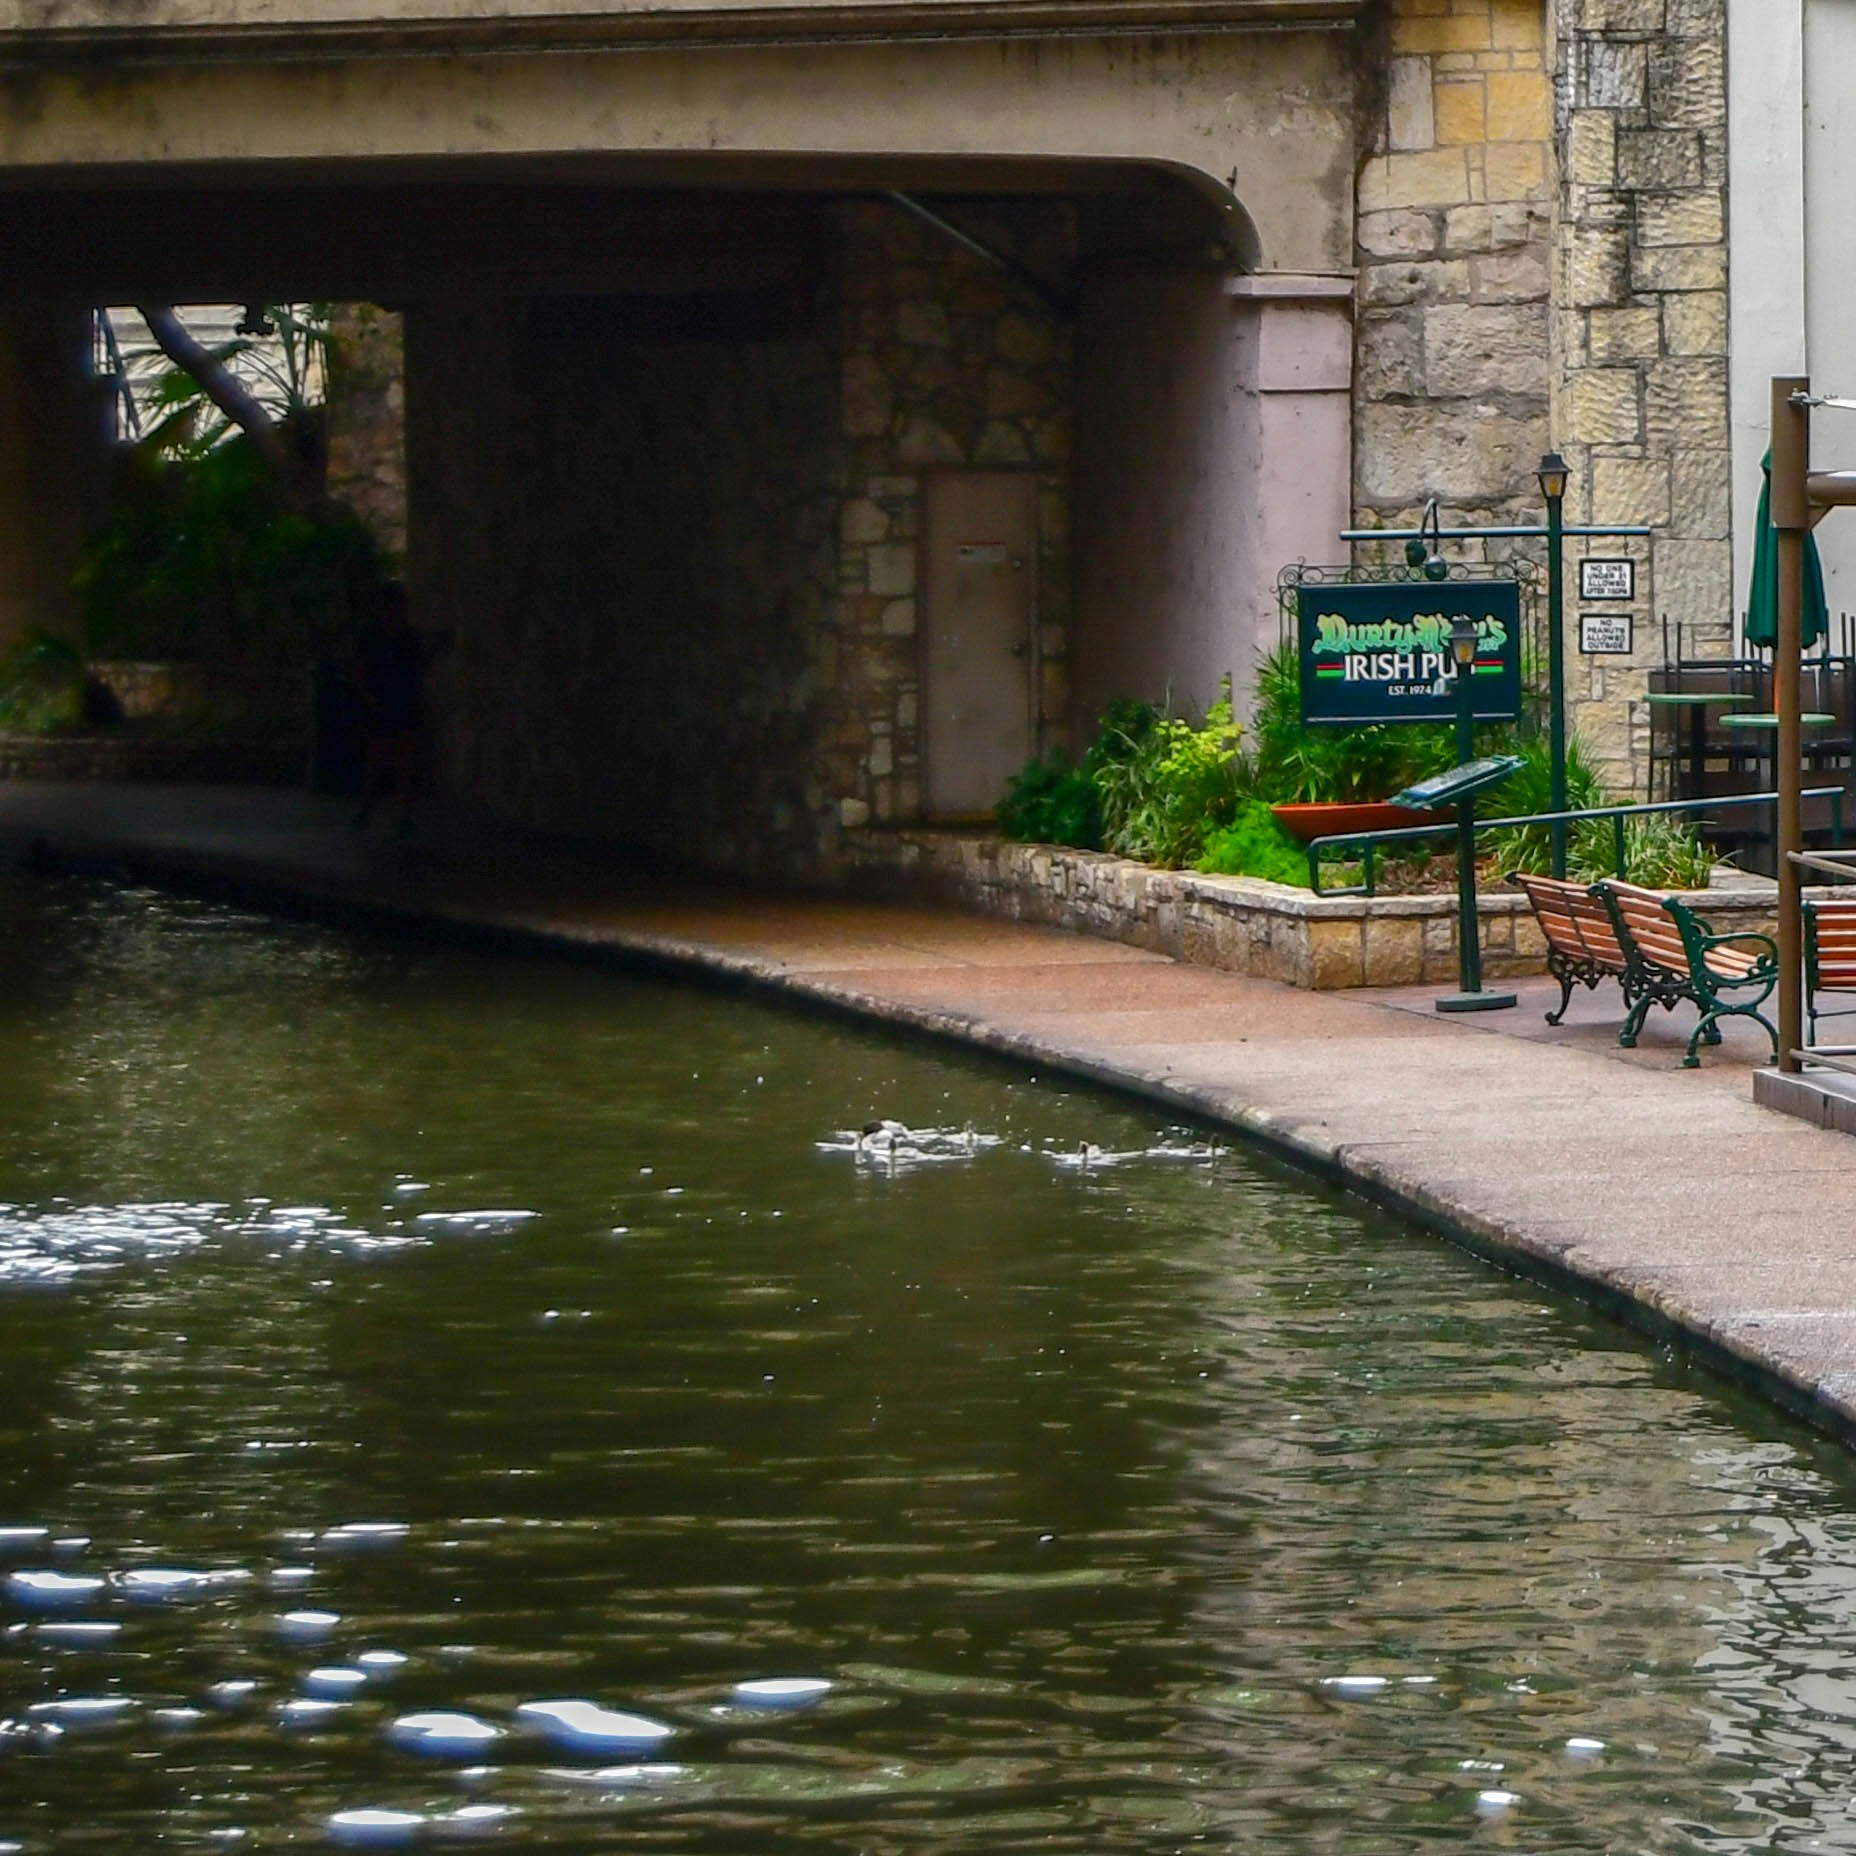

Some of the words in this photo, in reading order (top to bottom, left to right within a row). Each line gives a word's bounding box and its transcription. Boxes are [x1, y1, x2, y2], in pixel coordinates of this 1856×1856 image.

[1586, 626, 1625, 634] PEANUTS
[1586, 634, 1626, 642] ALLOWED
[1344, 653, 1416, 682] IRISH
[1421, 652, 1476, 680] PU
[1388, 685, 1408, 696] EST.
[1409, 685, 1432, 695] 1974
